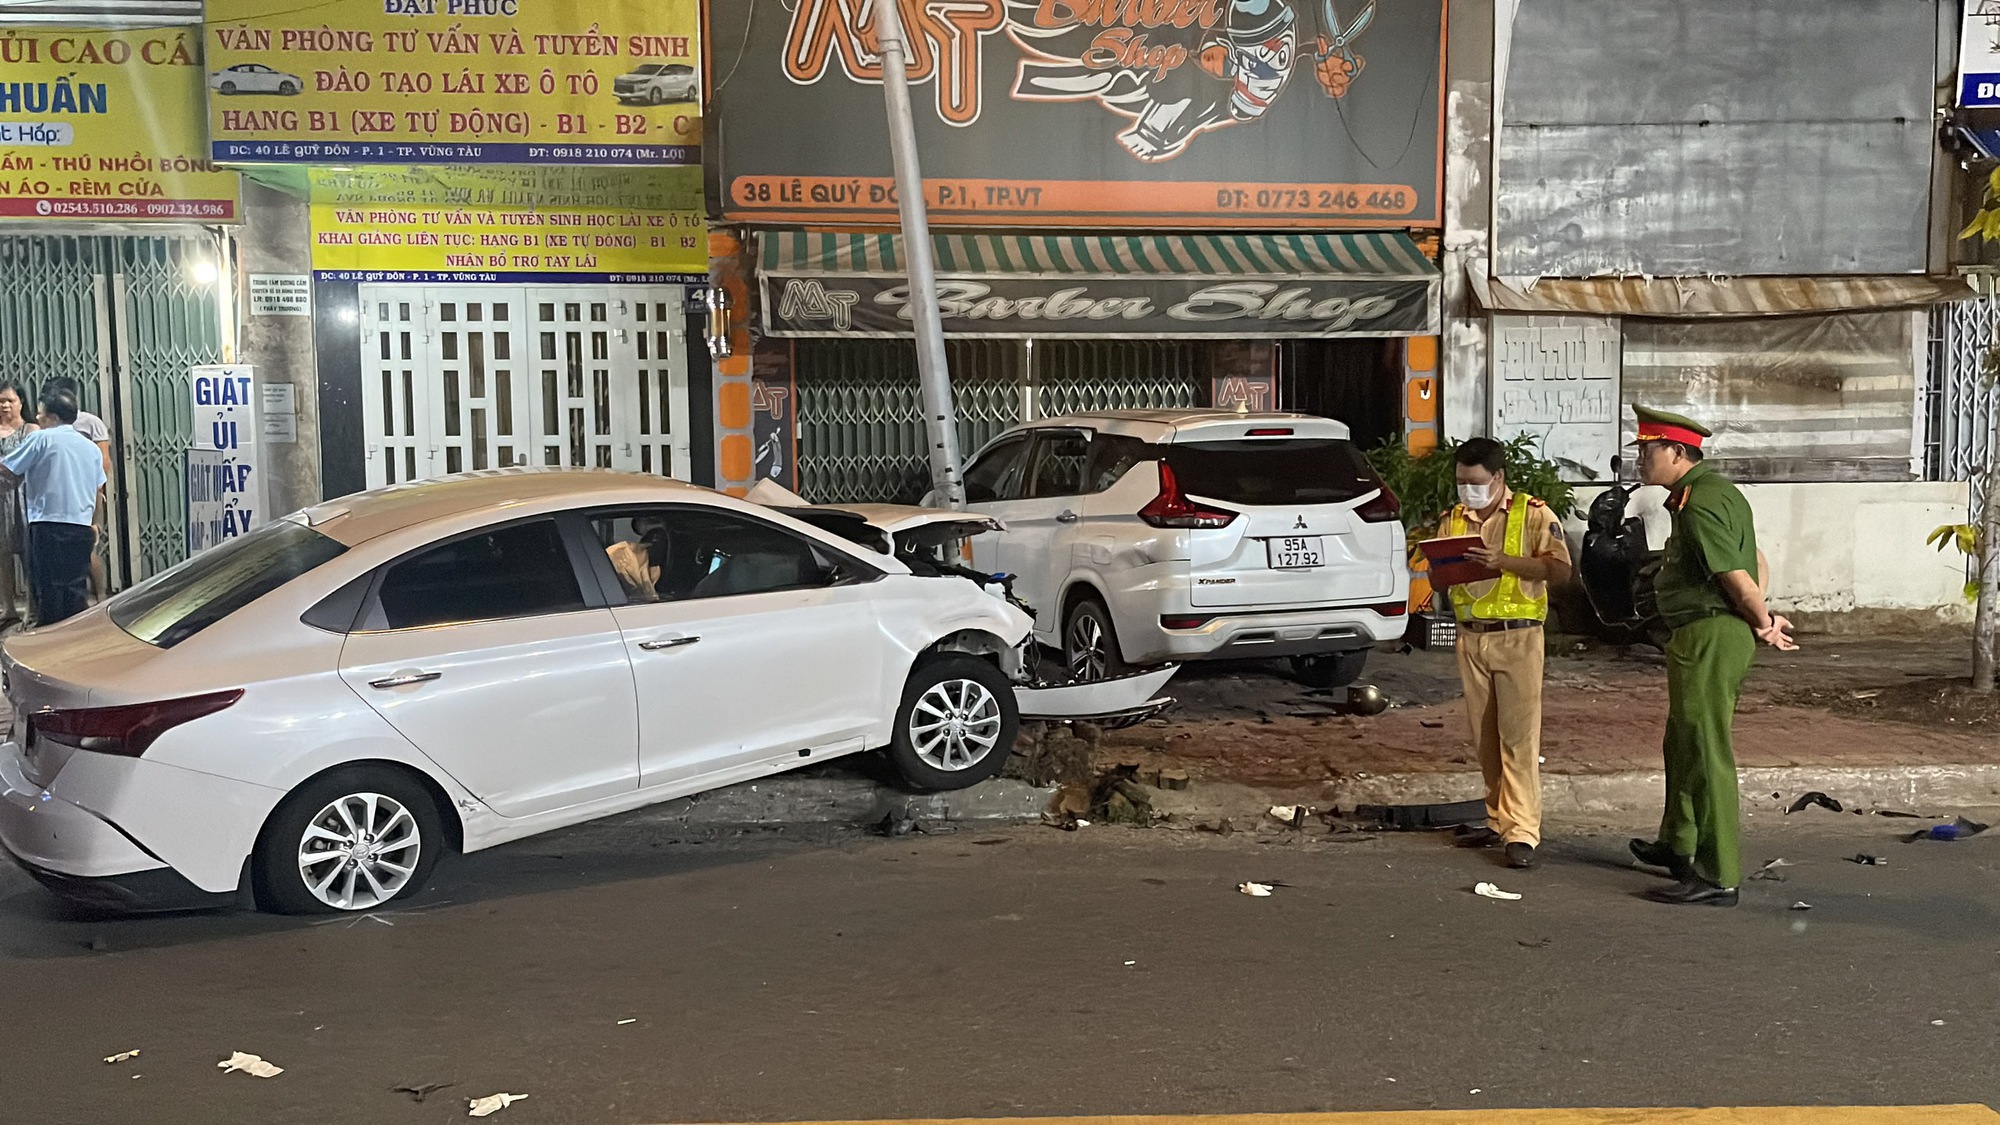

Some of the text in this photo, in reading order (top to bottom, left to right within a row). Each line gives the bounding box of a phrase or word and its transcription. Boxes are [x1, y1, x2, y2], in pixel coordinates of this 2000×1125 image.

[50, 38, 131, 65] CAO
[216, 22, 690, 57] VĂN PHÒNG TƯ VẤN VÀ TUYỂN SINH
[1081, 27, 1187, 83] Shop
[315, 64, 599, 98] ĐÀO TẠO LÁI XE Ô TÔ
[222, 110, 298, 136] HẠNG
[308, 111, 340, 131] B1
[352, 109, 395, 135] (XE
[405, 108, 439, 138] TỰ
[450, 107, 530, 138] ĐỘNG)
[557, 114, 587, 134] B1
[615, 115, 647, 135] B2
[673, 115, 690, 136] C
[52, 154, 91, 171] THÚ
[99, 151, 153, 172] NHỒI
[230, 145, 251, 155] ĐC:
[256, 145, 270, 155] 40
[275, 144, 290, 155] LÊ
[324, 144, 350, 155] ĐÔN
[362, 146, 373, 156] P.
[378, 147, 384, 156] 1
[396, 146, 416, 156] TP.
[457, 145, 482, 157] TÀU
[529, 147, 549, 157] ĐT:
[553, 148, 582, 158] 0918
[585, 148, 607, 158] 210
[610, 148, 633, 158] 074
[636, 148, 659, 159] (Mr.
[19, 177, 49, 195] ÁO
[69, 178, 111, 195] RÈM
[118, 177, 164, 196] CỬA
[743, 182, 771, 202] 38
[780, 178, 802, 203] LÊ
[810, 179, 860, 203] QUÝ
[984, 185, 1042, 207] TP.VT
[1217, 189, 1249, 208] ĐT:
[1256, 190, 1310, 208] 0773
[1318, 190, 1359, 209] 246
[1366, 191, 1405, 209] 468
[336, 209, 364, 223] VĂN
[369, 209, 417, 224] PHÒNG
[422, 211, 440, 223] TƯ
[444, 208, 472, 225] VẤN
[477, 211, 495, 225] VÀ
[550, 214, 581, 225] SINH
[587, 215, 615, 227] HỌC
[646, 215, 664, 226] XE
[318, 232, 353, 244] KHAI
[358, 229, 402, 245] GIẢNG
[407, 231, 438, 245] LIÊN
[444, 234, 475, 248] TỤC:
[480, 234, 518, 248] HẠNG
[523, 235, 539, 246] B1
[545, 234, 567, 248] (XE
[650, 236, 666, 247] B1
[680, 237, 697, 248] B2
[544, 256, 570, 268] TAY
[321, 272, 336, 280] ĐC:
[339, 272, 349, 280] 40
[352, 271, 363, 280] LÊ
[386, 271, 405, 280] ĐÔN
[437, 273, 450, 281] TP.
[479, 272, 497, 281] TÀU
[874, 281, 1155, 320] Barber
[1167, 281, 1398, 331] Shop
[195, 371, 251, 411] GIẶT
[212, 412, 238, 450] ỦI
[1284, 538, 1307, 551] 95A
[1278, 553, 1319, 566] 127.92
